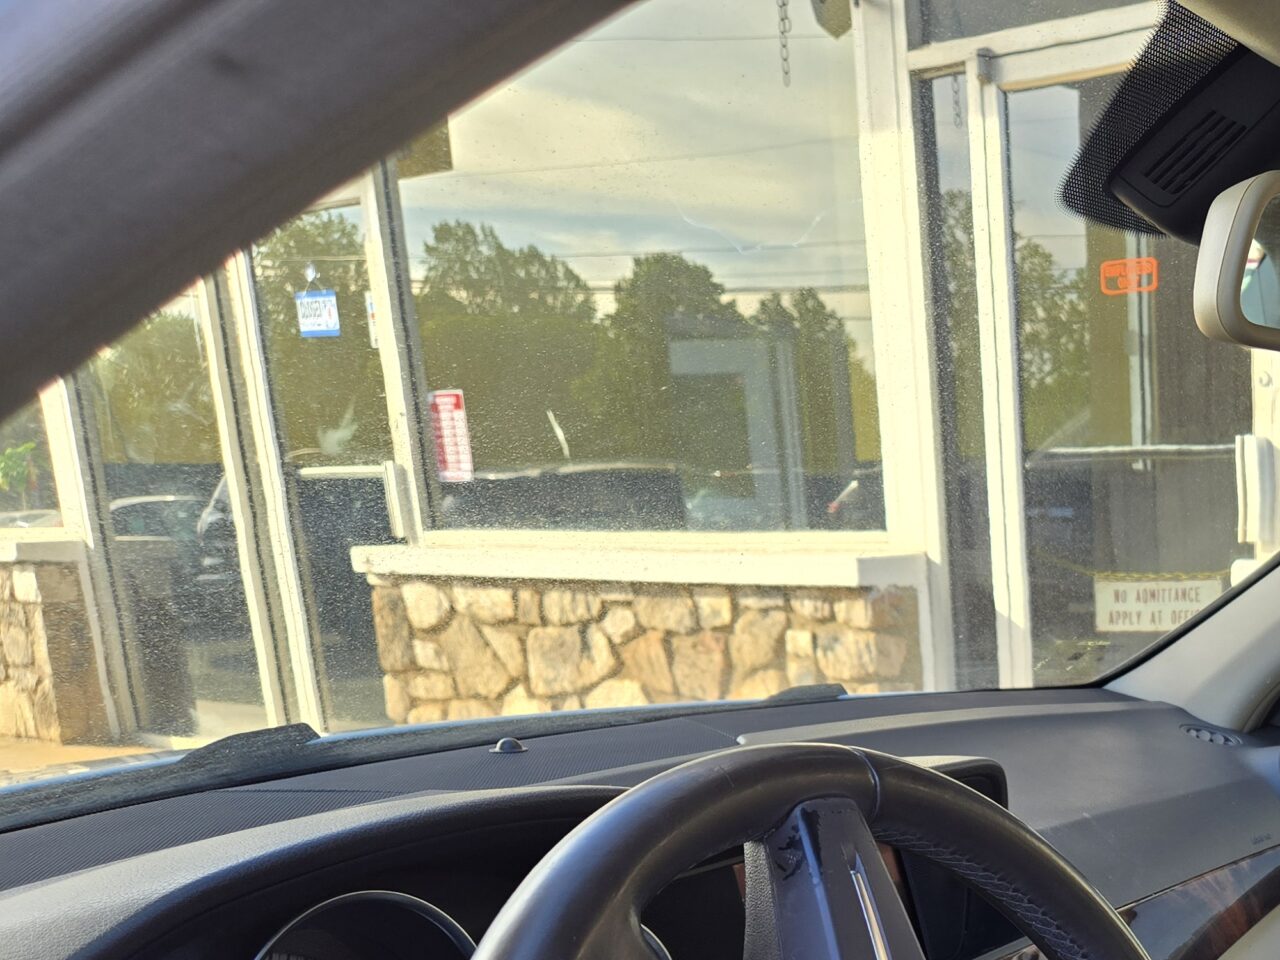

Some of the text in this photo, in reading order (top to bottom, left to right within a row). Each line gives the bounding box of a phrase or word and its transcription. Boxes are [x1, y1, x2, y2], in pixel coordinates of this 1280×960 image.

[1113, 586, 1201, 604] NO ADMITTANCE
[1108, 610, 1142, 626] APPLY
[1150, 610, 1163, 625] AT
